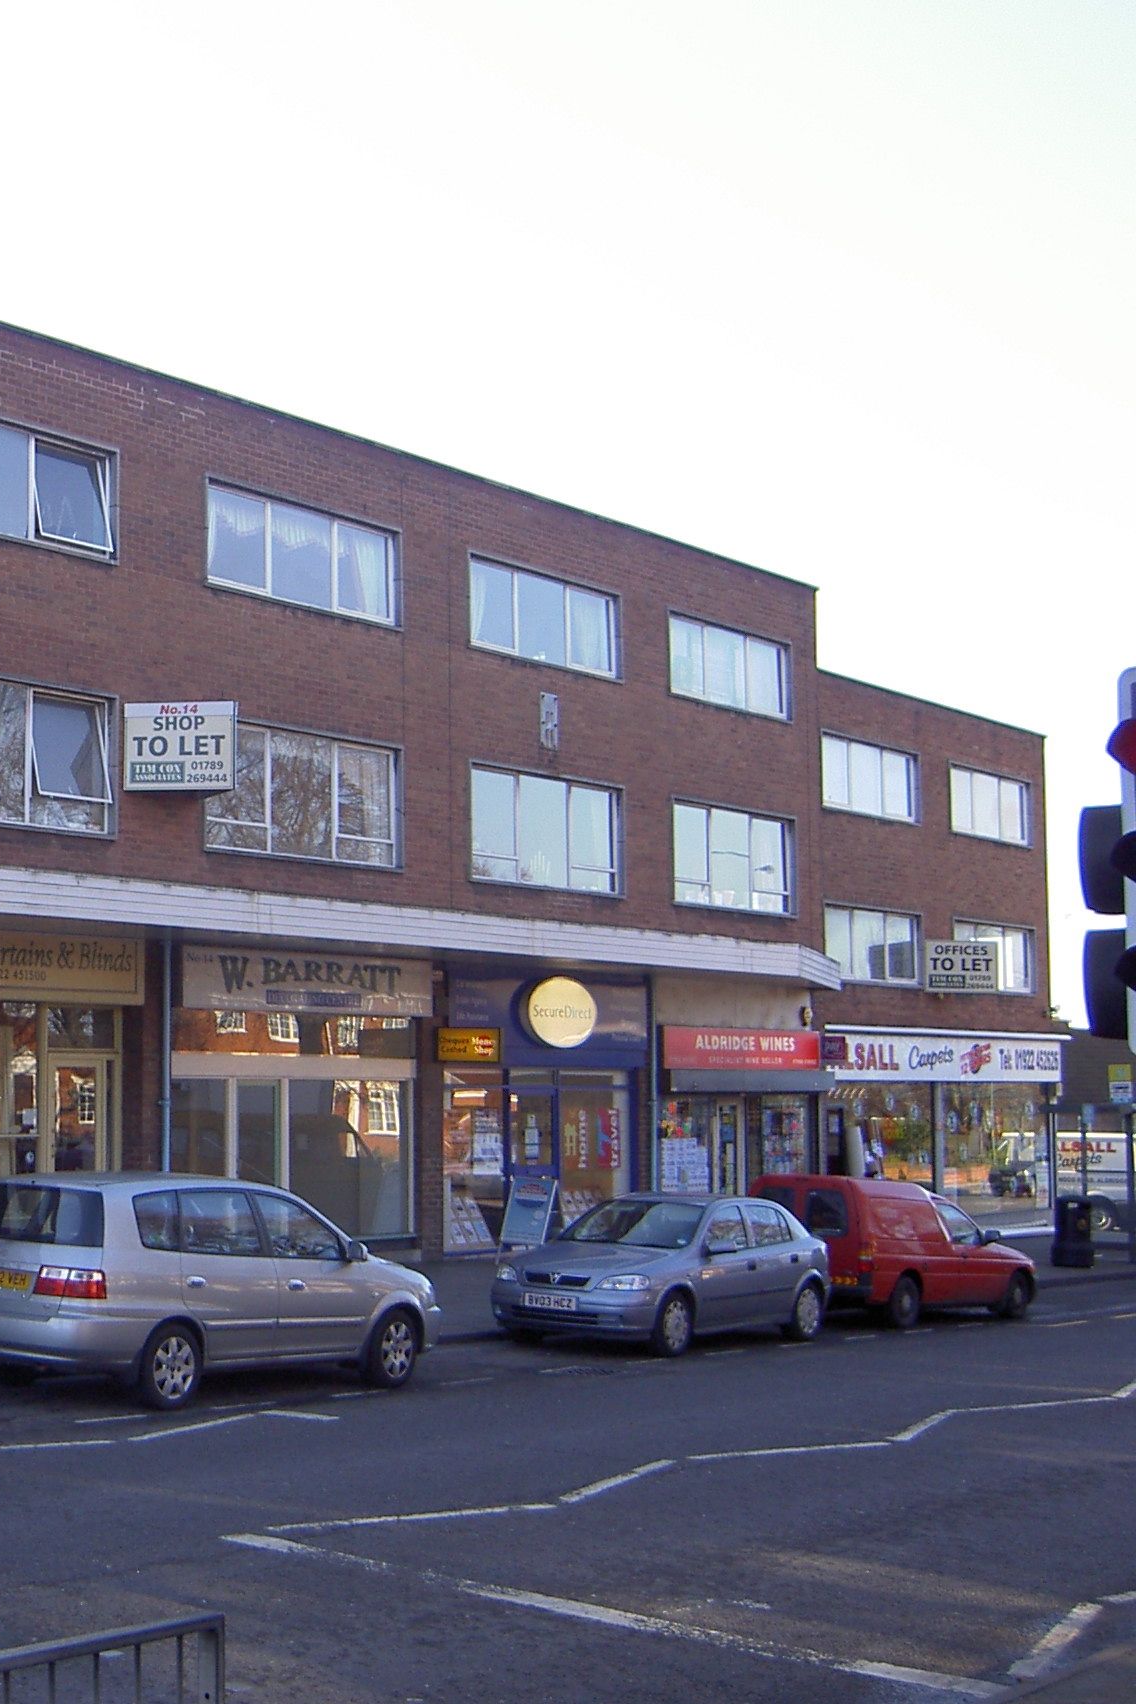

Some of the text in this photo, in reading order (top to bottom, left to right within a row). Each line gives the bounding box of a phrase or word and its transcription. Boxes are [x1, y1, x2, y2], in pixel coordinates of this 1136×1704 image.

[152, 716, 205, 732] SHOP
[132, 734, 226, 757] TO LET
[190, 760, 225, 771] 01789
[56, 942, 76, 969] &
[78, 941, 132, 972] Blinds
[934, 944, 989, 956] OFFICES
[929, 957, 993, 971] TO LET
[217, 953, 401, 997] W. BARRATT
[695, 1033, 797, 1051] ALDRIDGE WINES
[908, 1044, 955, 1071] Carpets
